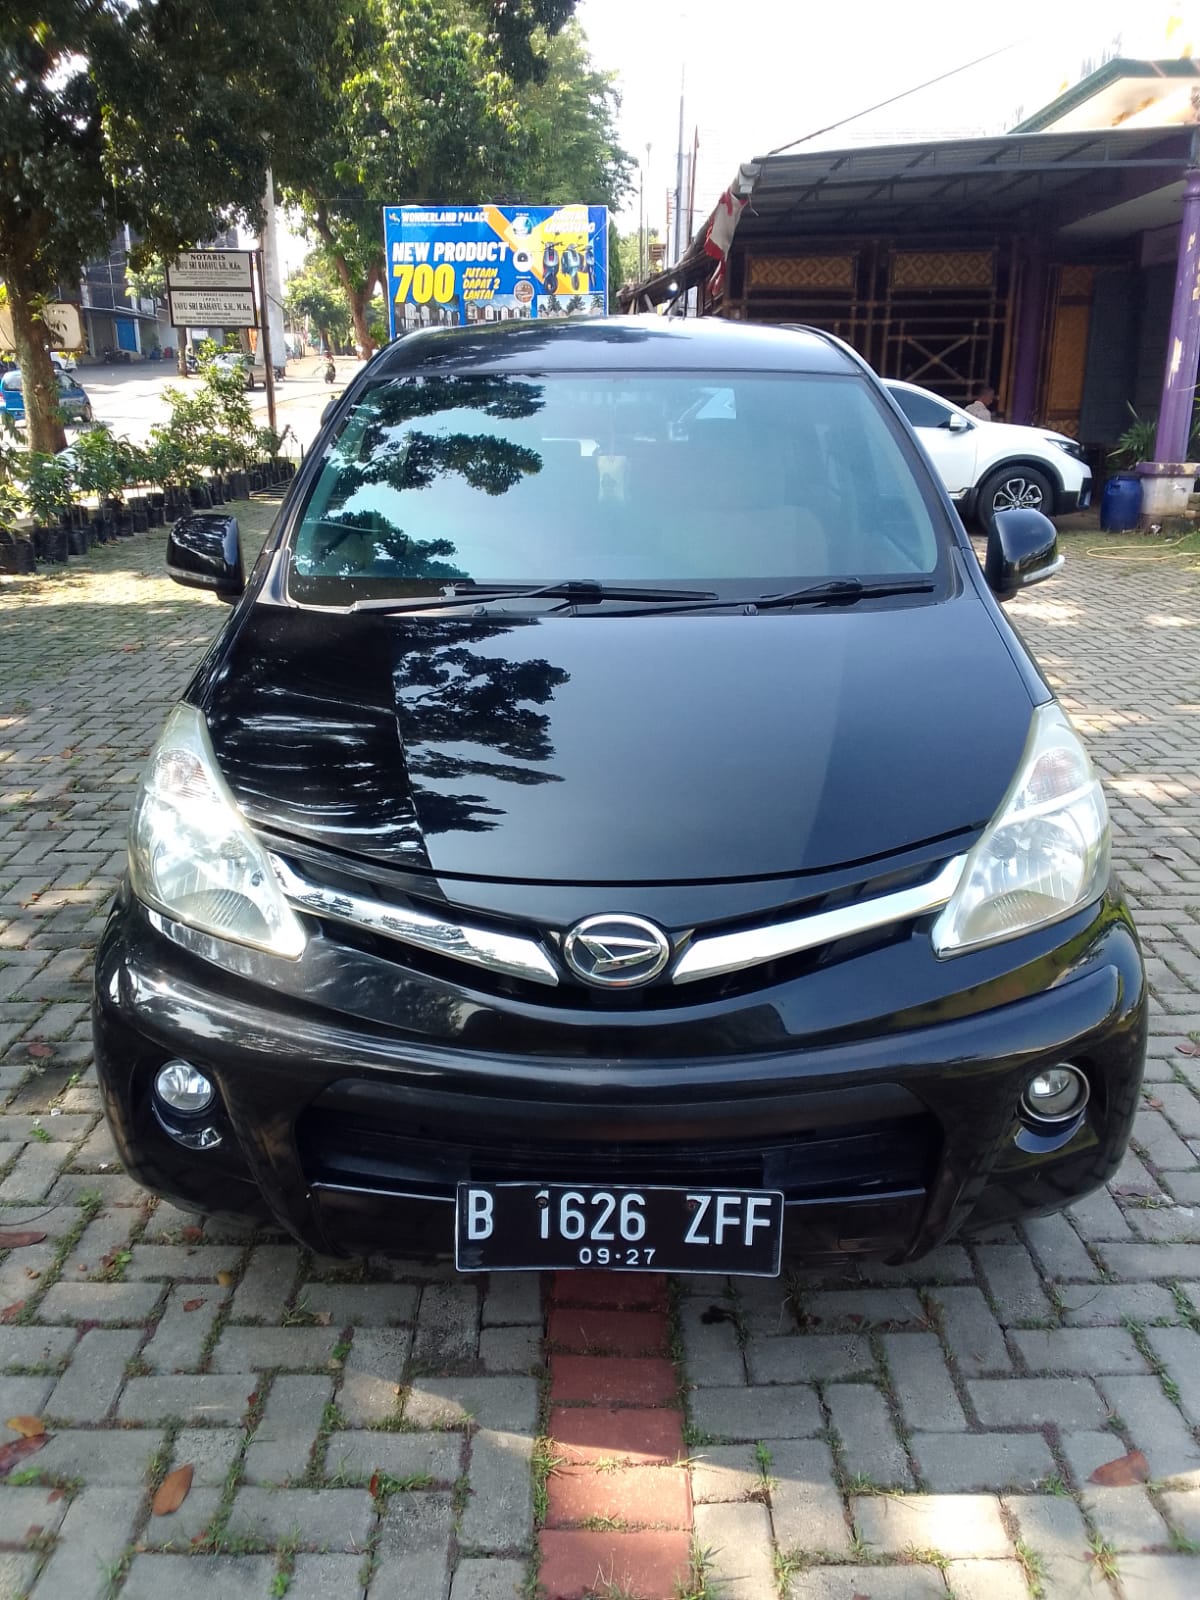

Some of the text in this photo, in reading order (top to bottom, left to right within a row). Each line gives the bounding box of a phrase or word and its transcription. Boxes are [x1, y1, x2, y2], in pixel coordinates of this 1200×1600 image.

[401, 212, 489, 222] WONDERLAND PALACE
[392, 241, 510, 262] NEW PRODUCT
[462, 267, 498, 278] JUTAAN
[393, 263, 455, 303] 700
[463, 278, 500, 289] DAPAT 2
[463, 289, 495, 300] LANTAI
[189, 302, 198, 310] SRI
[468, 1190, 493, 1240] B
[535, 1190, 646, 1241] 1626
[684, 1195, 772, 1246] ZFF
